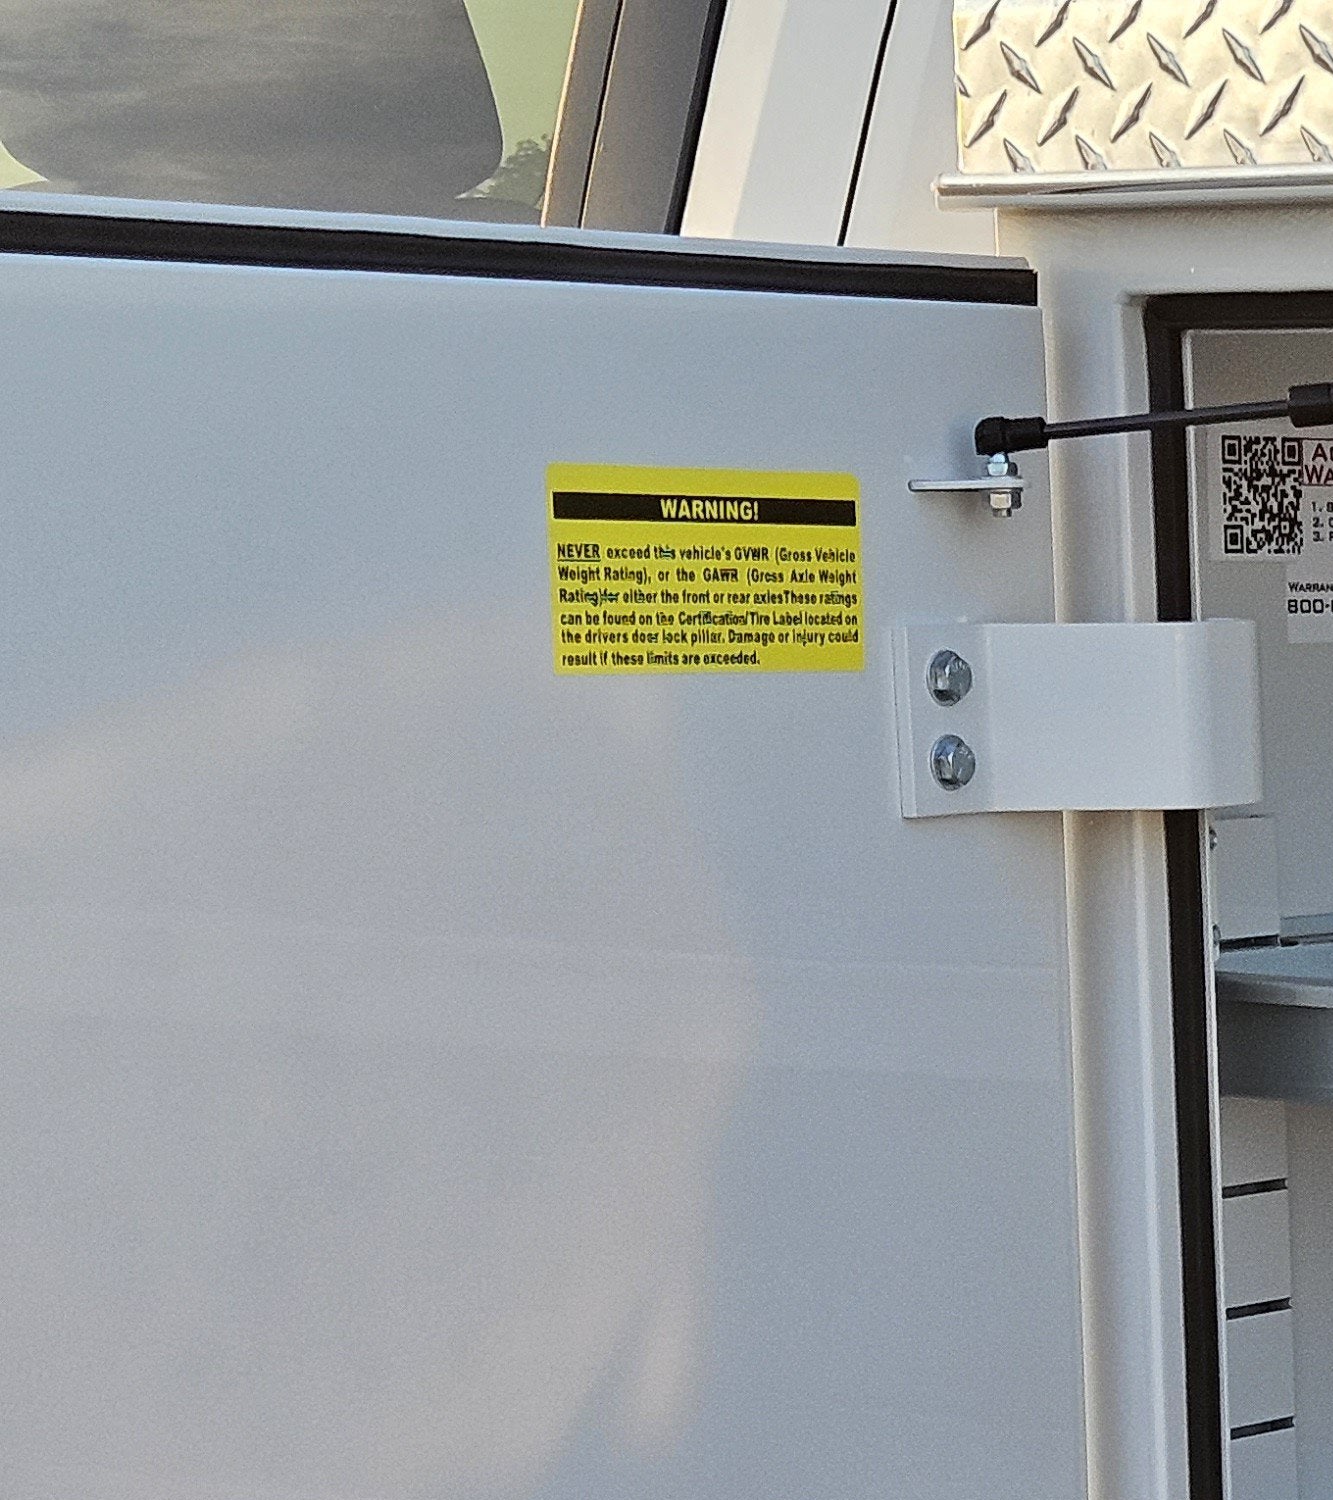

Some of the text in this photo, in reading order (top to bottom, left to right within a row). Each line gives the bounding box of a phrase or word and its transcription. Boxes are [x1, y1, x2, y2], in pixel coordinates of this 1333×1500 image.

[660, 498, 759, 521] WARNING!
[1311, 501, 1323, 513] 1.
[1312, 517, 1324, 528] 2.
[1312, 531, 1324, 542] 3.
[557, 543, 856, 565] NEVER exceed this vehicle's GVWR (Gross Vehicle
[558, 566, 857, 587] Weight Rating), or the GAWR (Gross Axle Weight
[622, 588, 657, 604] either
[660, 588, 679, 604] the
[682, 588, 711, 604] front
[713, 592, 724, 605] or
[726, 592, 751, 605] rear
[819, 590, 858, 609] ratings
[560, 612, 583, 626] can
[585, 610, 600, 626] be
[602, 610, 637, 626] found
[639, 613, 653, 626] on
[655, 611, 676, 626] the
[773, 610, 803, 626] Label
[804, 610, 843, 626] located
[845, 614, 858, 626] on
[561, 628, 582, 644] the
[584, 628, 629, 644] drivers
[631, 629, 660, 644] door
[662, 629, 689, 644] lock
[728, 628, 776, 647] Damage
[777, 632, 791, 644] or
[827, 629, 859, 643] could
[562, 650, 761, 667] result if these limits are exceeded.
